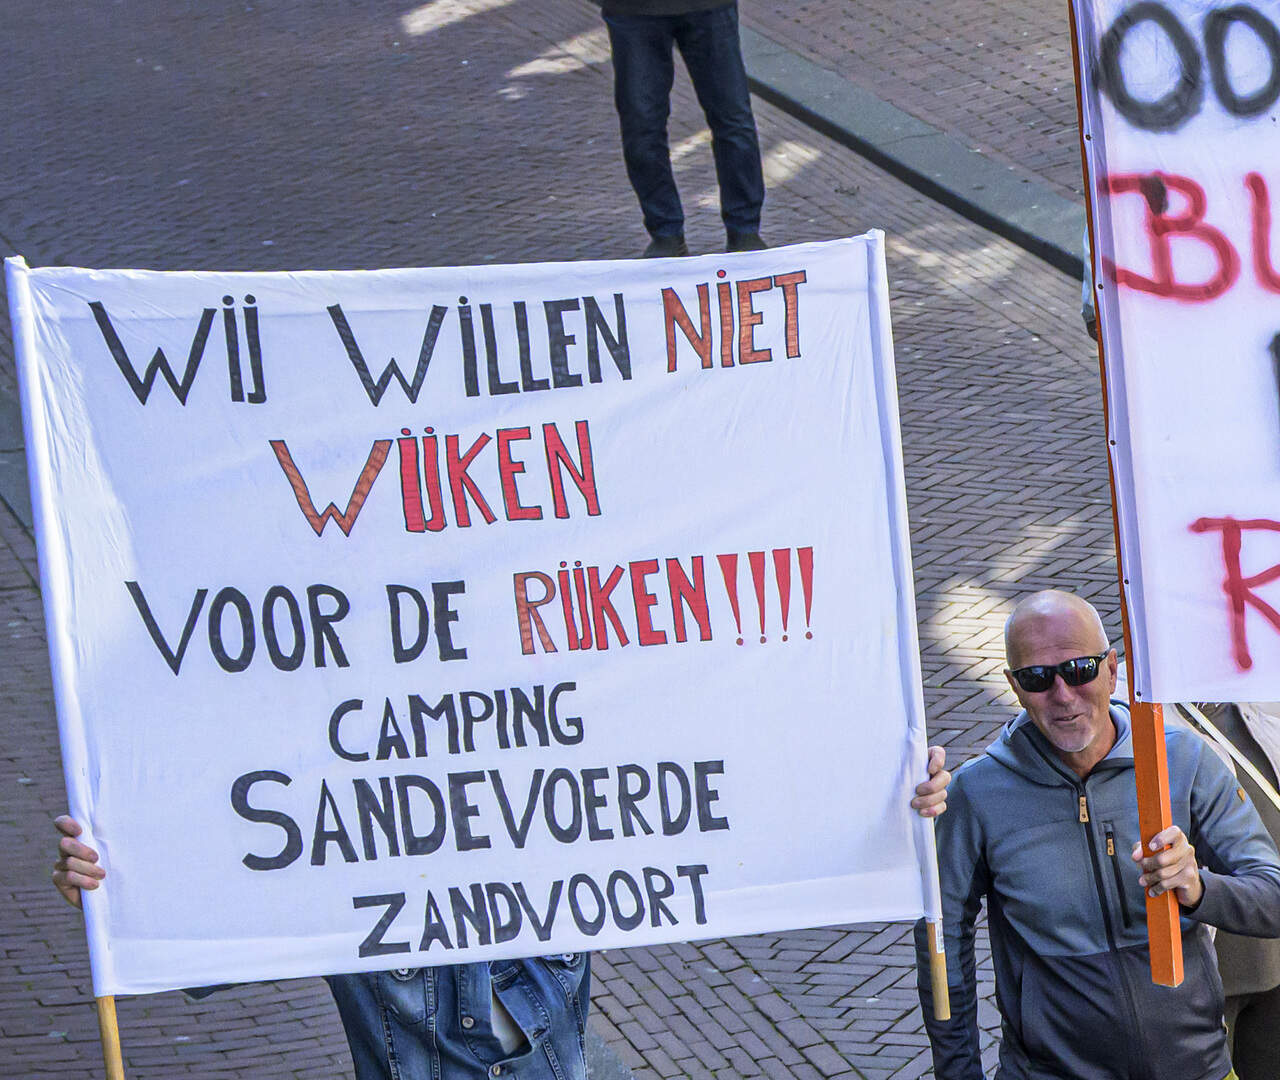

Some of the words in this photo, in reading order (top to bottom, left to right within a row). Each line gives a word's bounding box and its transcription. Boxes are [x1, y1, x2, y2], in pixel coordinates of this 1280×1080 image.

[326, 293, 633, 405] WILLEN
[269, 420, 602, 537] WIJKEN
[124, 580, 351, 676] VOOR
[389, 580, 469, 664] DE
[328, 681, 585, 762] CAMPING
[230, 759, 730, 870] SANDEVOERDE
[352, 864, 709, 959] ZANDVOORT
